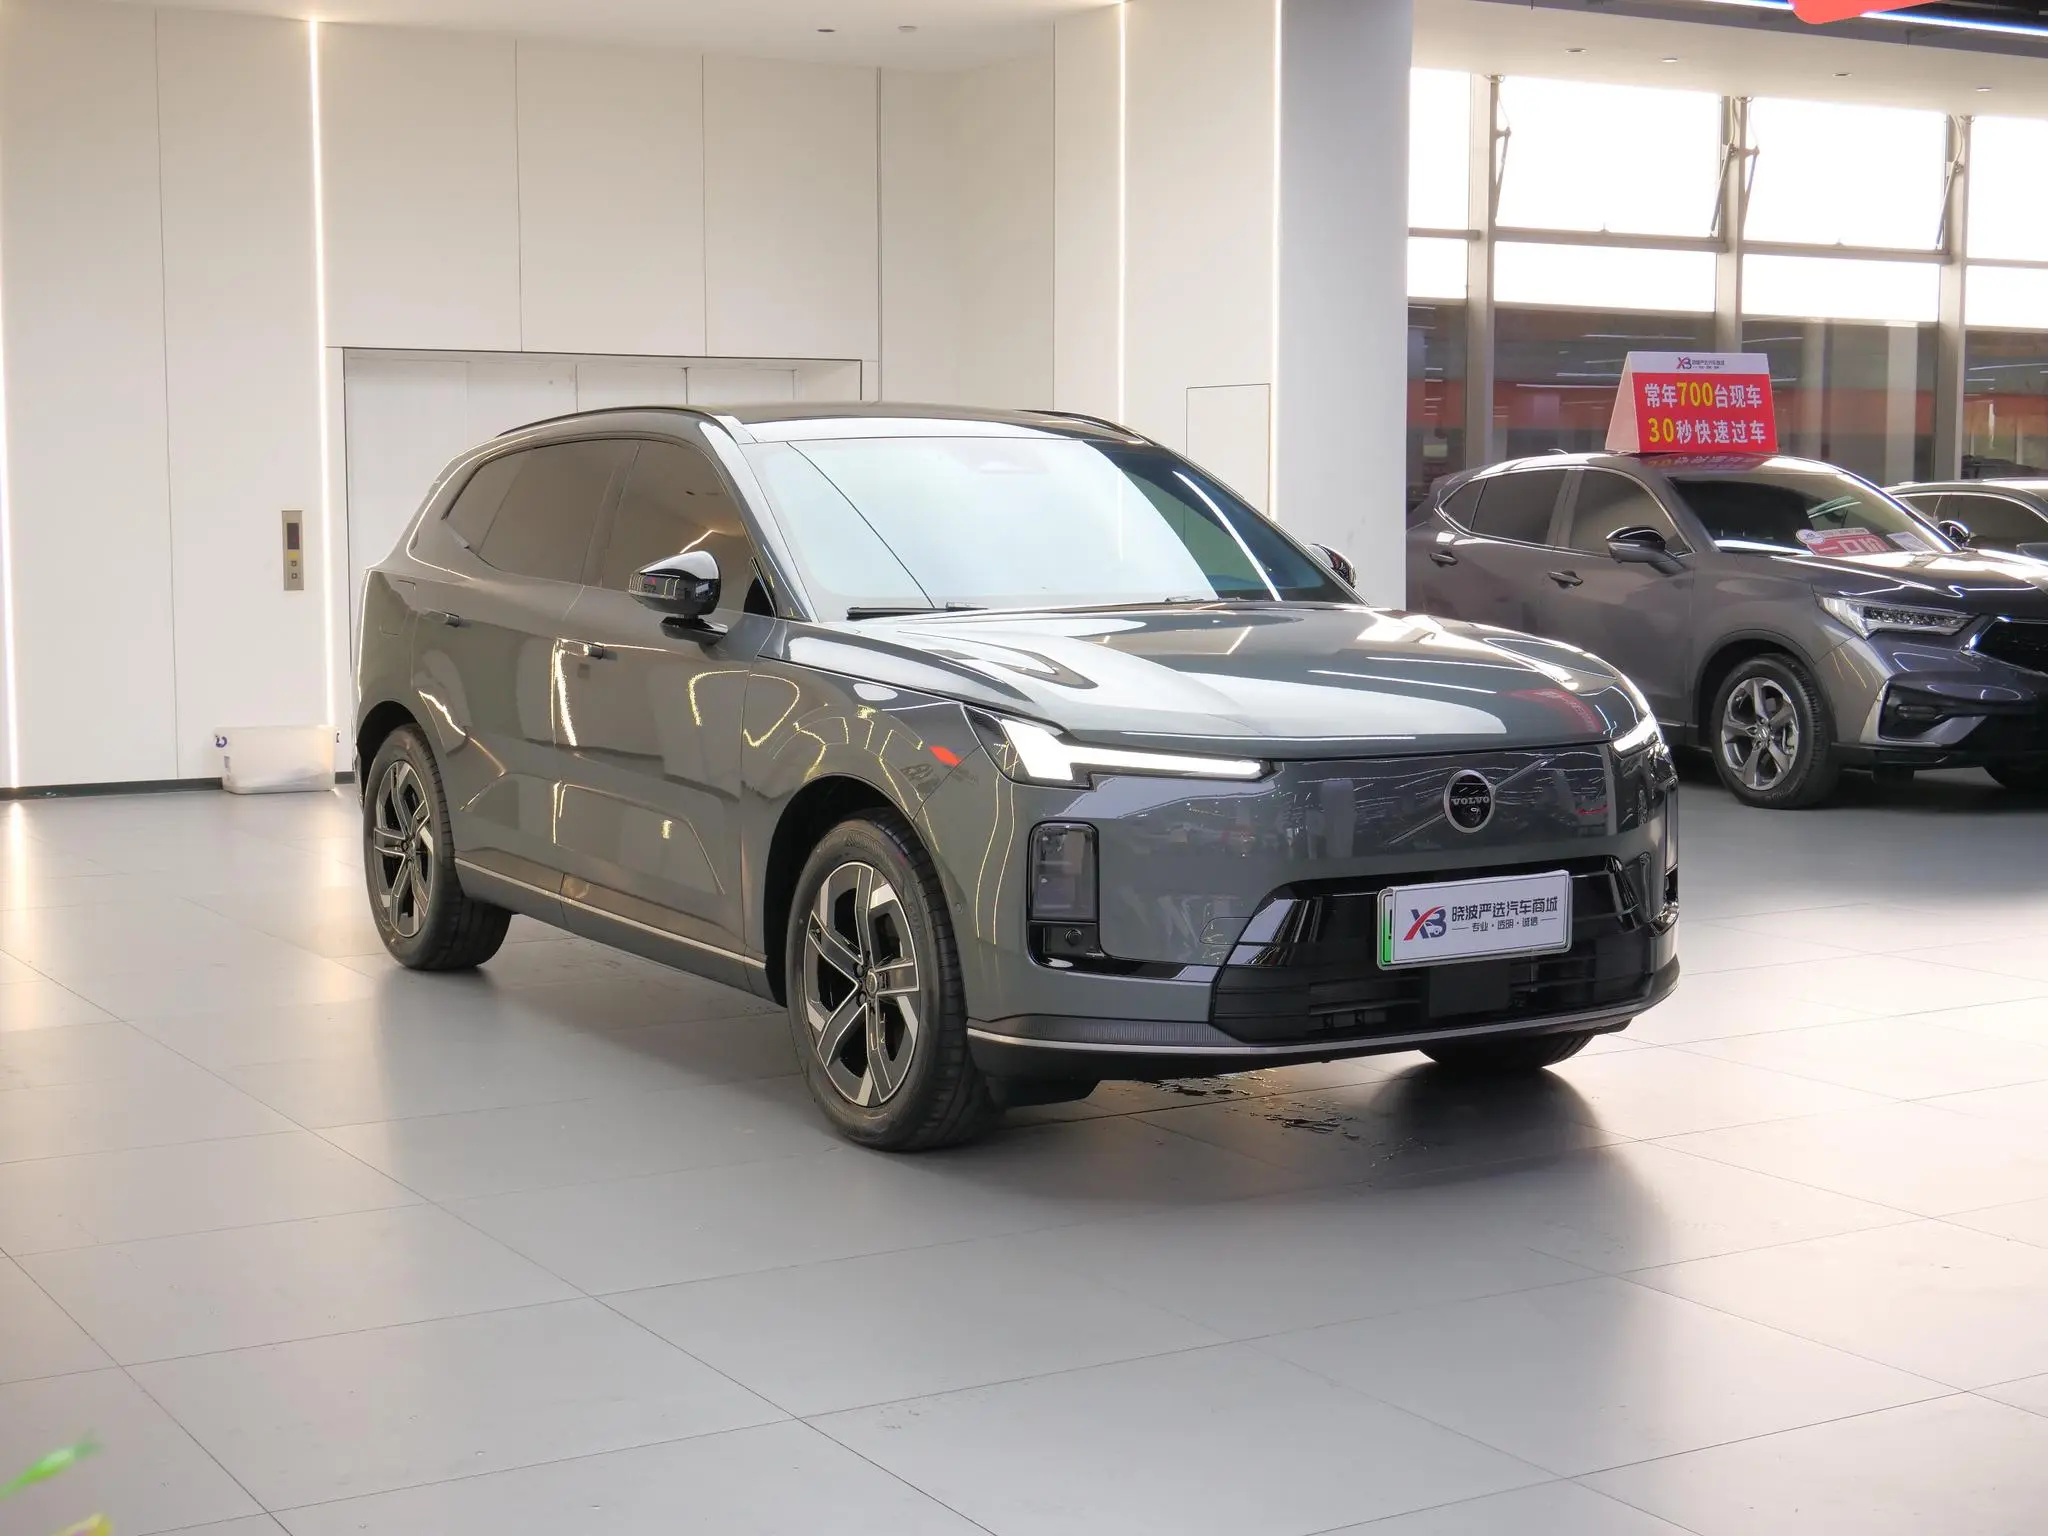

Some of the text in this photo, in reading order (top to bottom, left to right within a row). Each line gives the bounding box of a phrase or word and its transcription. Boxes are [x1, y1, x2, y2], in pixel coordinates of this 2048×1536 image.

[1644, 382, 1763, 409] 常年700台现车
[1647, 417, 1766, 444] 30秒快速过车
[1451, 796, 1490, 806] VOLVO
[1451, 896, 1559, 922] 晓波严选汽车商城
